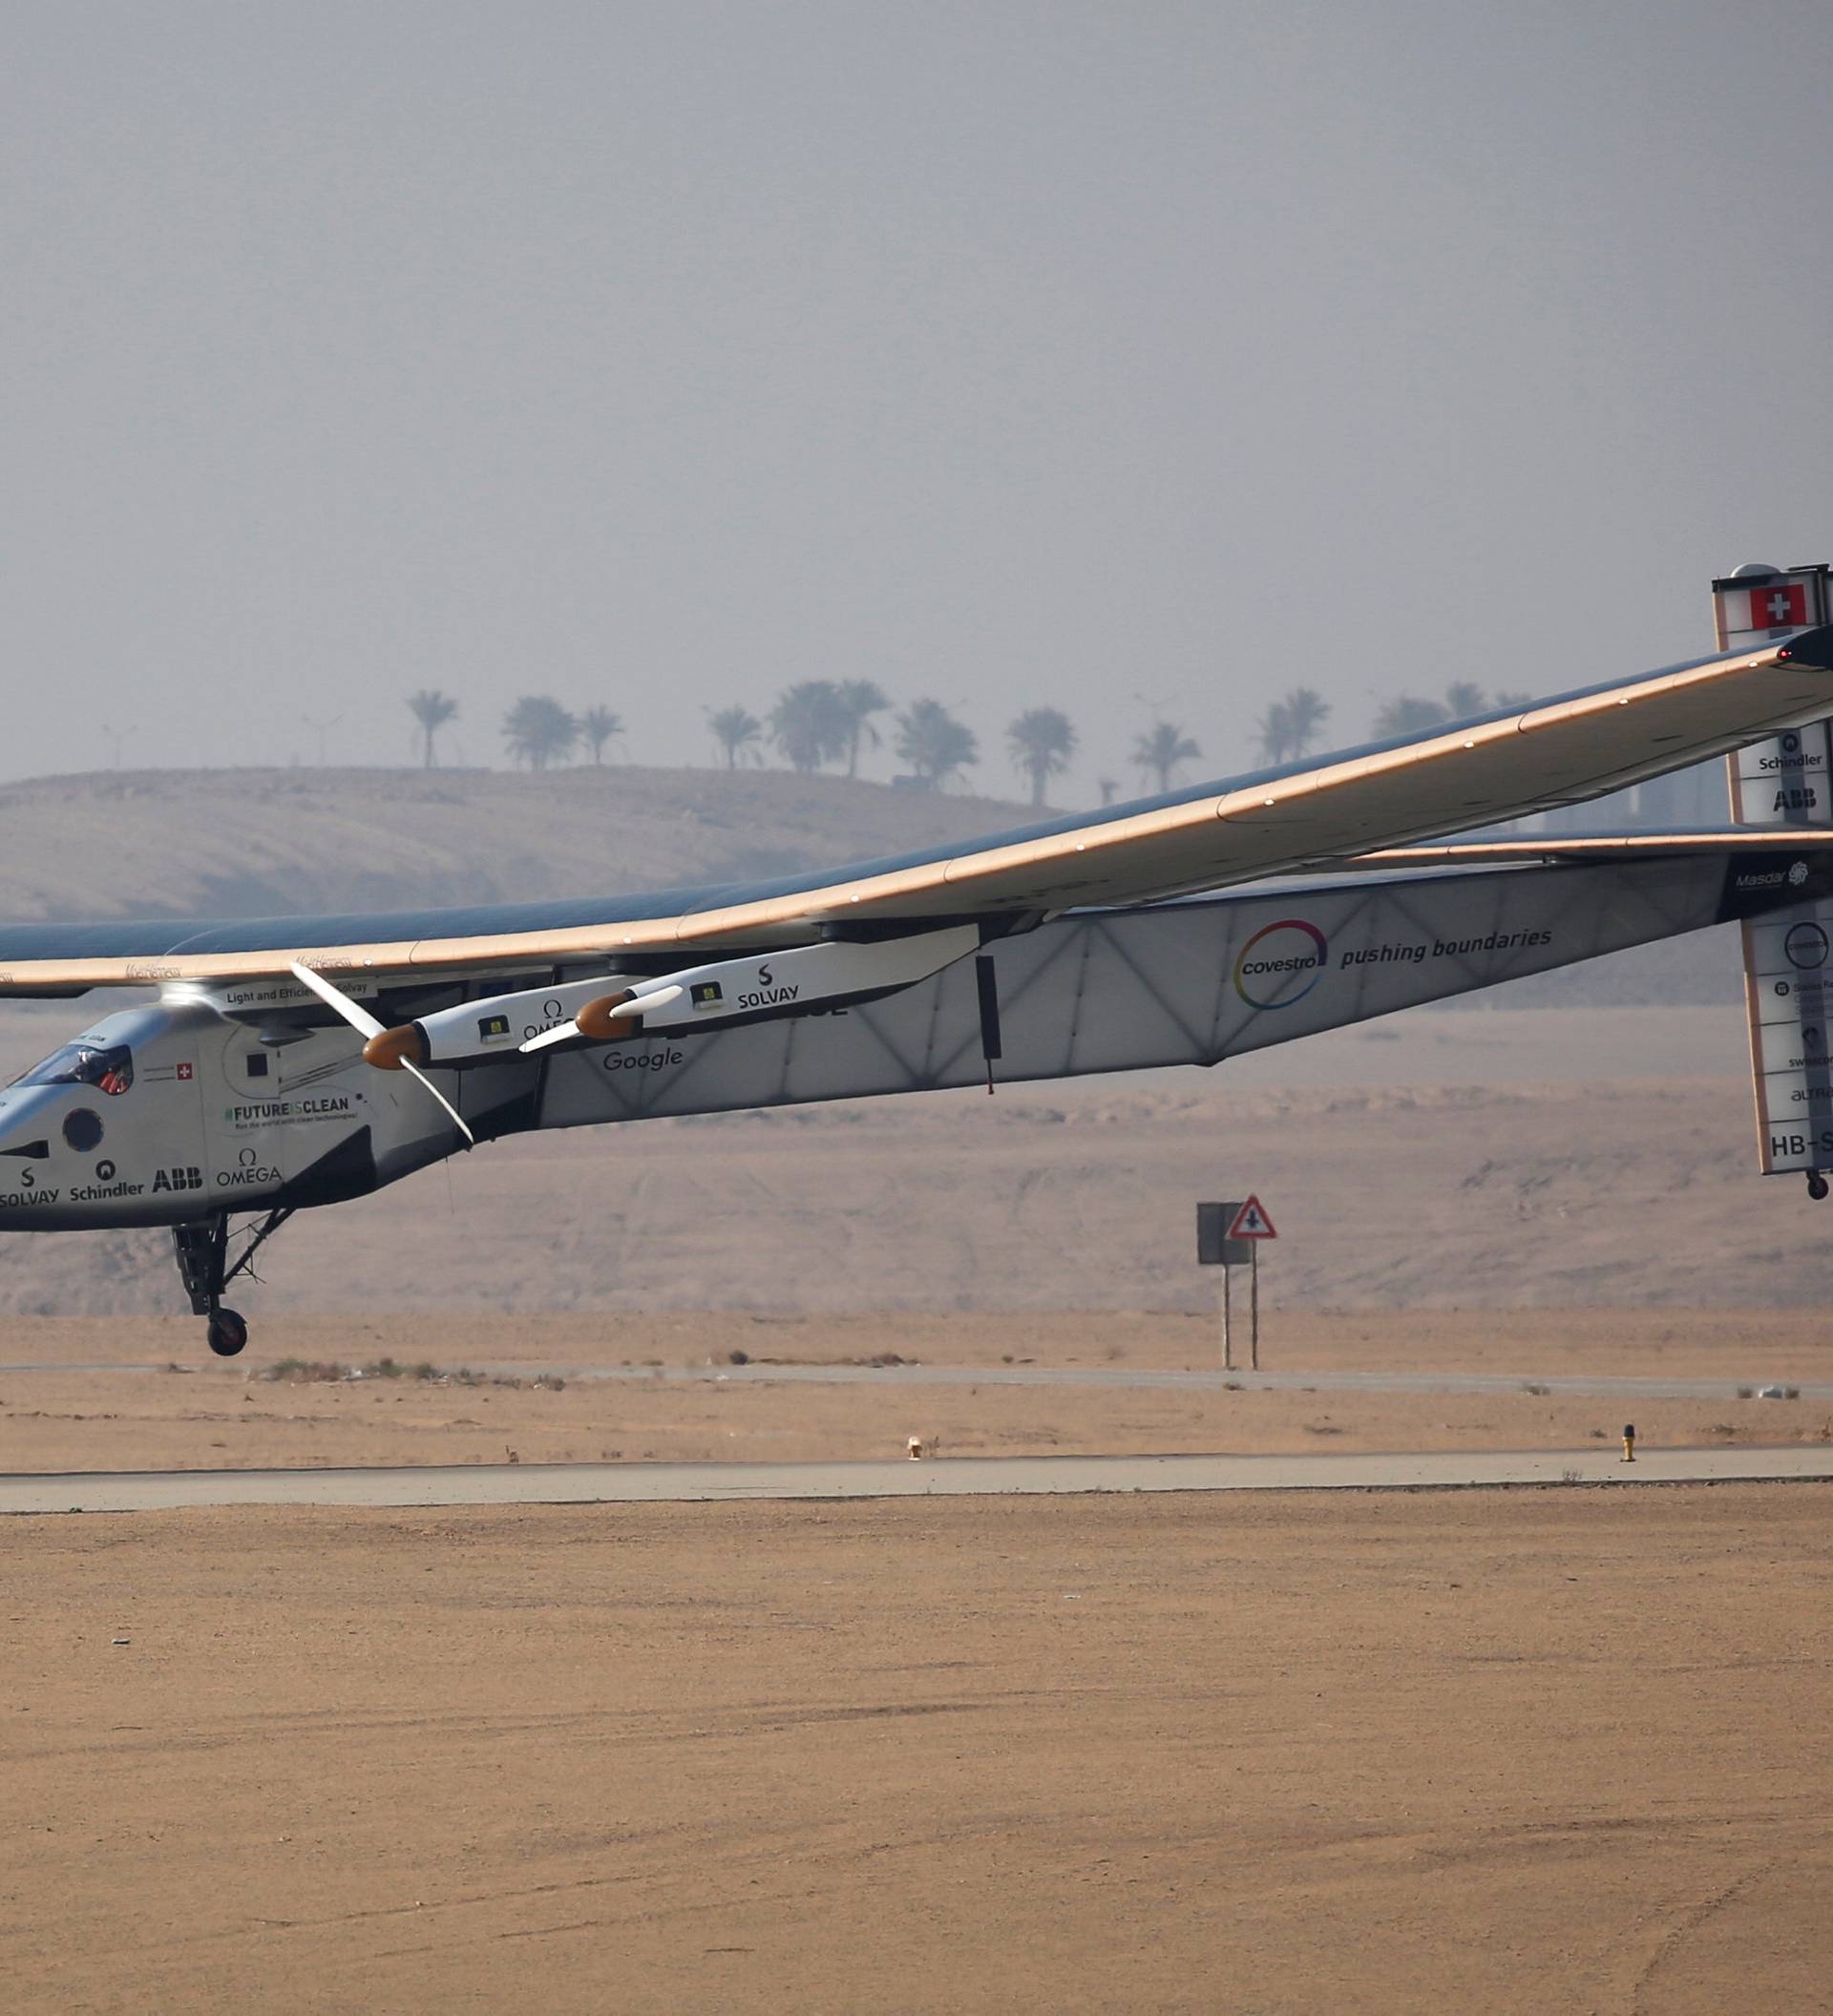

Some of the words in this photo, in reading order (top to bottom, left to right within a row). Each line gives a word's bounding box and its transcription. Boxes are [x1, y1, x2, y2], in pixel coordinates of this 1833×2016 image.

[1759, 754, 1822, 769] Schindler
[1773, 788, 1817, 811] ABB
[1736, 872, 1786, 886] Masdar
[1341, 943, 1426, 970] pushing
[1433, 929, 1551, 956] boundaries
[1242, 956, 1316, 975] covestro
[227, 992, 254, 1004] Light
[257, 990, 277, 1000] and
[738, 985, 799, 1009] SOLVAY
[603, 1047, 683, 1071] Google
[153, 1167, 203, 1192] ABB
[217, 1166, 283, 1186] OMEGA
[0, 1189, 59, 1208] SOLVAY
[70, 1182, 144, 1201] Schindler
